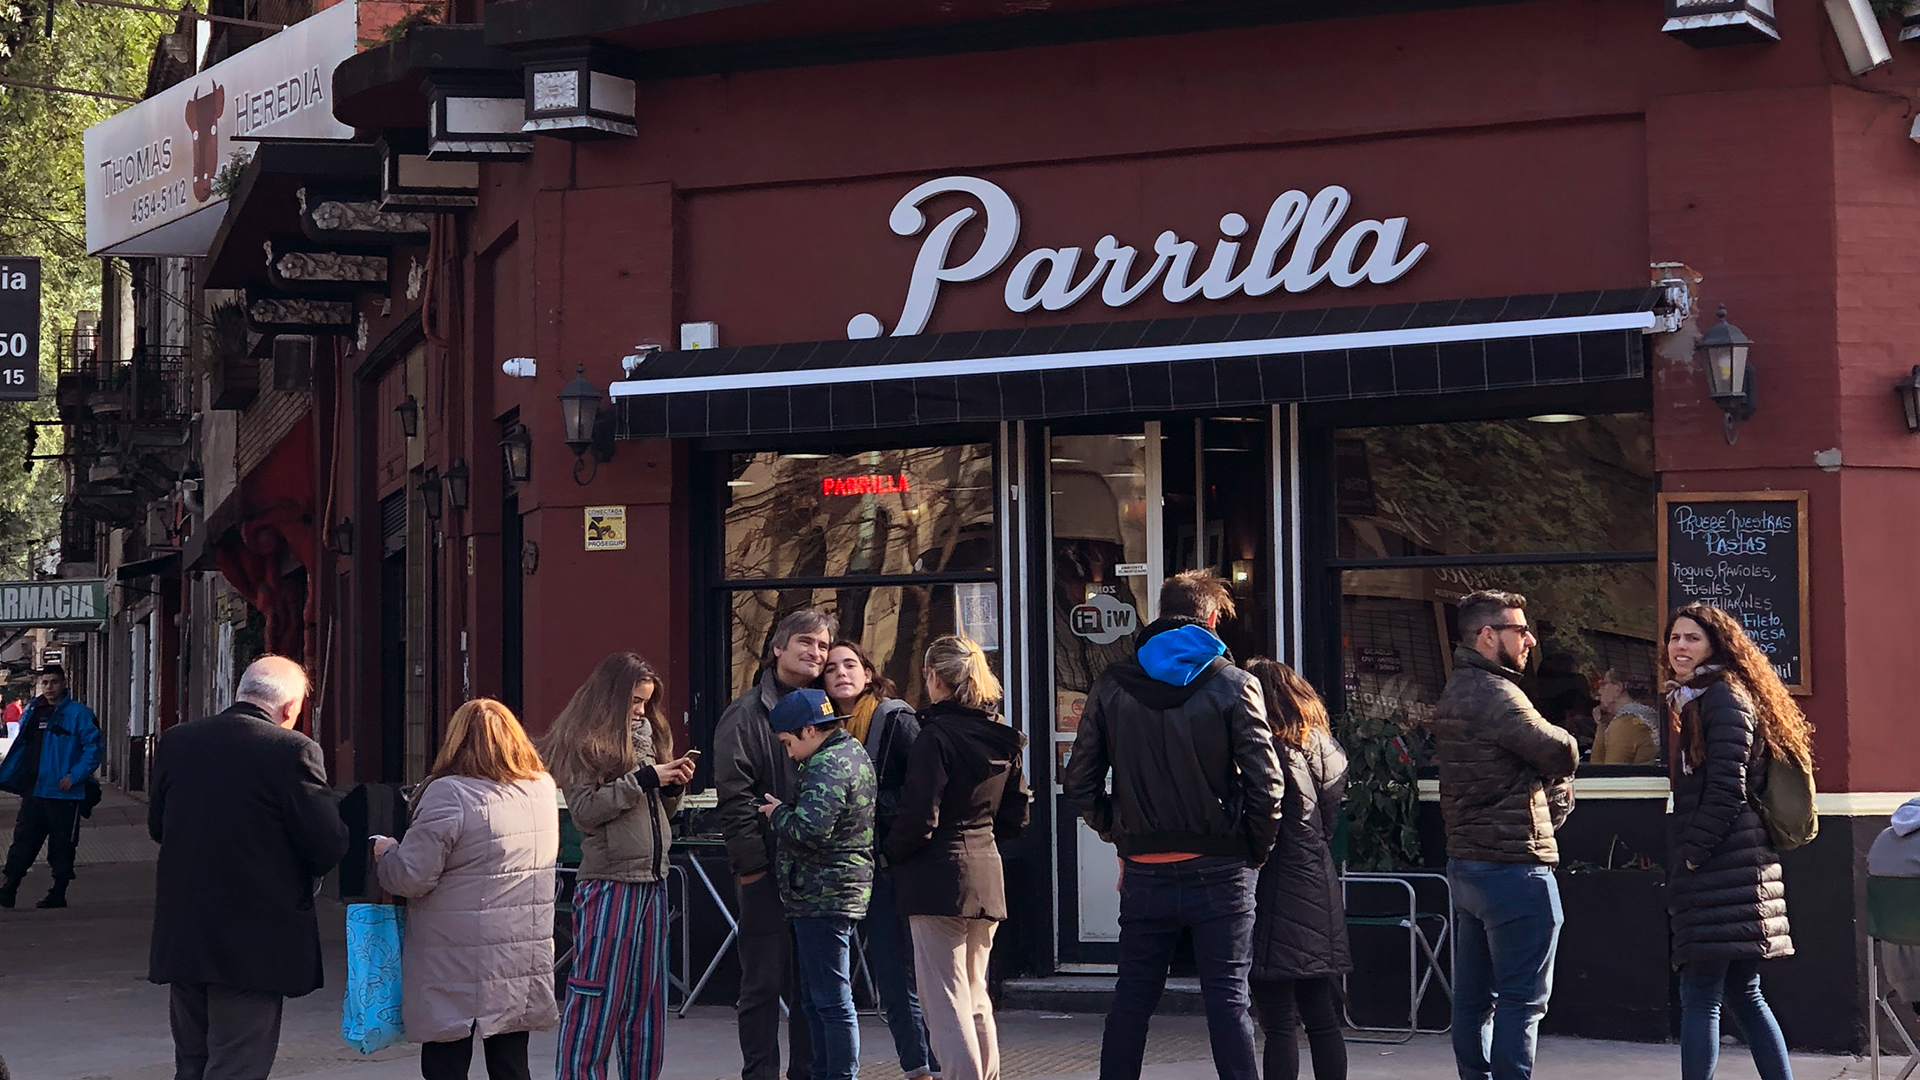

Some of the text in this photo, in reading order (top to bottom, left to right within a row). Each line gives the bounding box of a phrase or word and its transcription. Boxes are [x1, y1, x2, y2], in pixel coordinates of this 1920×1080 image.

[101, 67, 324, 196] THOMAS HEREDIA
[131, 180, 187, 224] 4554-5112
[847, 175, 1430, 341] Parrilla
[2, 369, 25, 385] 15
[823, 474, 910, 496] PARRILLA
[588, 508, 622, 516] CONECTADA
